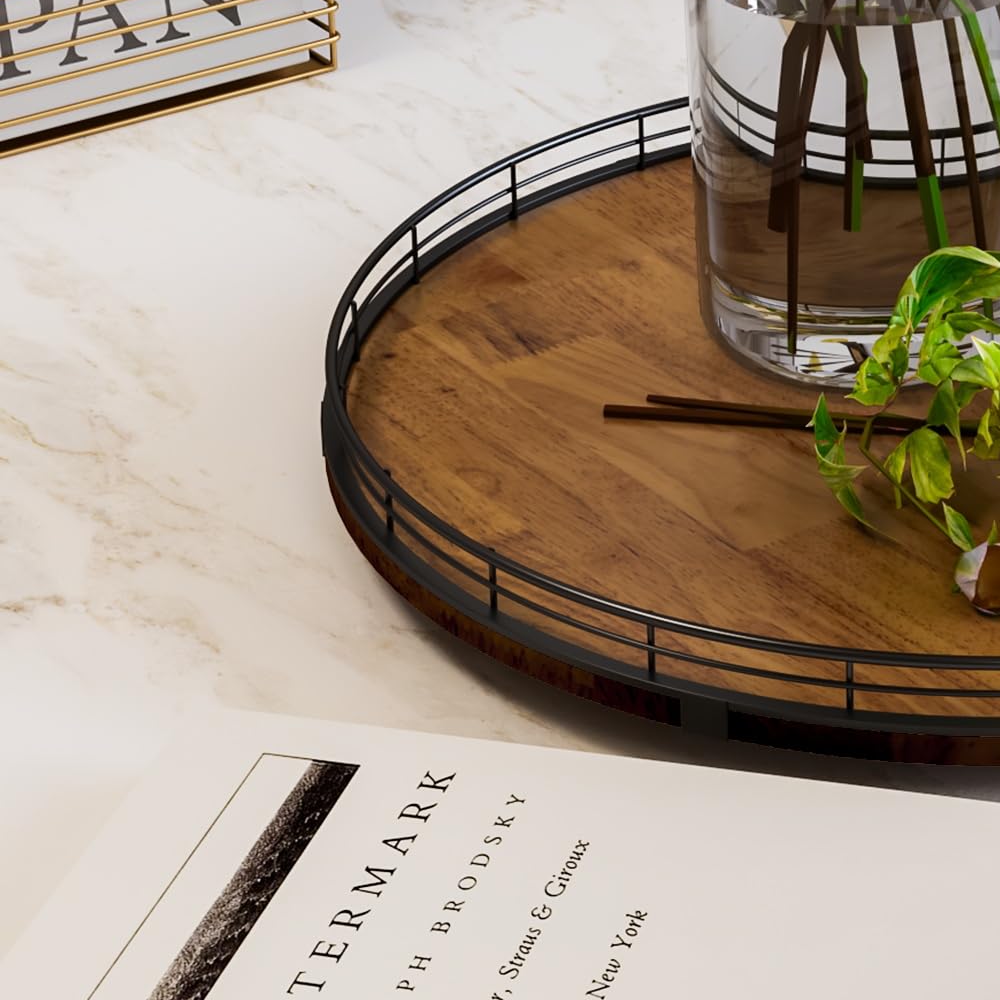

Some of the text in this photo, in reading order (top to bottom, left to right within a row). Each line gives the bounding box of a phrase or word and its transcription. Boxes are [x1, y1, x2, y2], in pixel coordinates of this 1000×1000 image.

[286, 768, 457, 996] TERMARK
[396, 793, 526, 992] PH BRODSKY
[498, 927, 542, 980] Straus
[530, 904, 553, 921] &
[544, 839, 590, 898] Giroux
[585, 910, 649, 1000] New York
